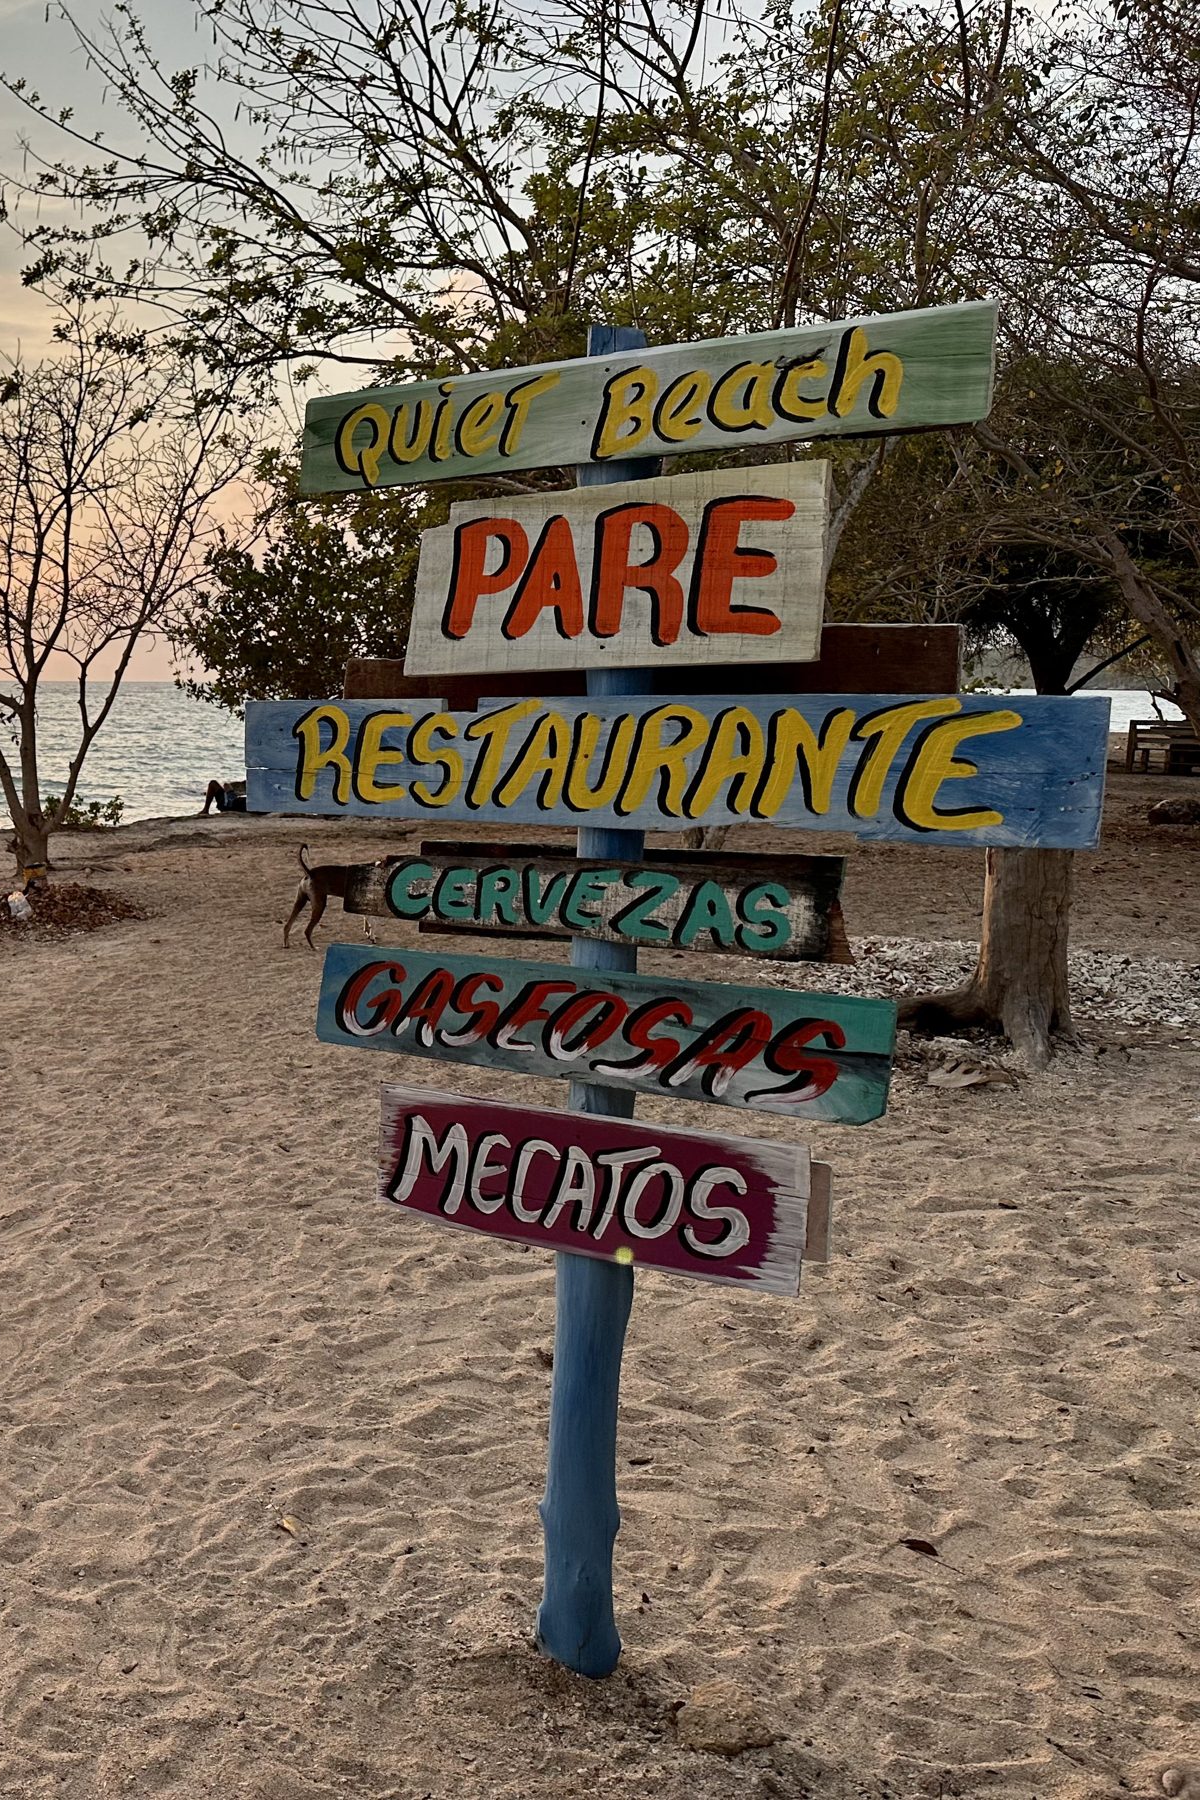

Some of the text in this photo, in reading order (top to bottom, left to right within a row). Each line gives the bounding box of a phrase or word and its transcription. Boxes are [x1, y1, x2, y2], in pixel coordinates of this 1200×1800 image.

[591, 326, 904, 461] Beach
[441, 494, 796, 647] PARE
[292, 697, 1025, 832] RESTAURANTE
[387, 859, 793, 952] CERVEZAS
[335, 960, 847, 1103] GASEOSAS
[389, 1114, 751, 1261] MECATOS
